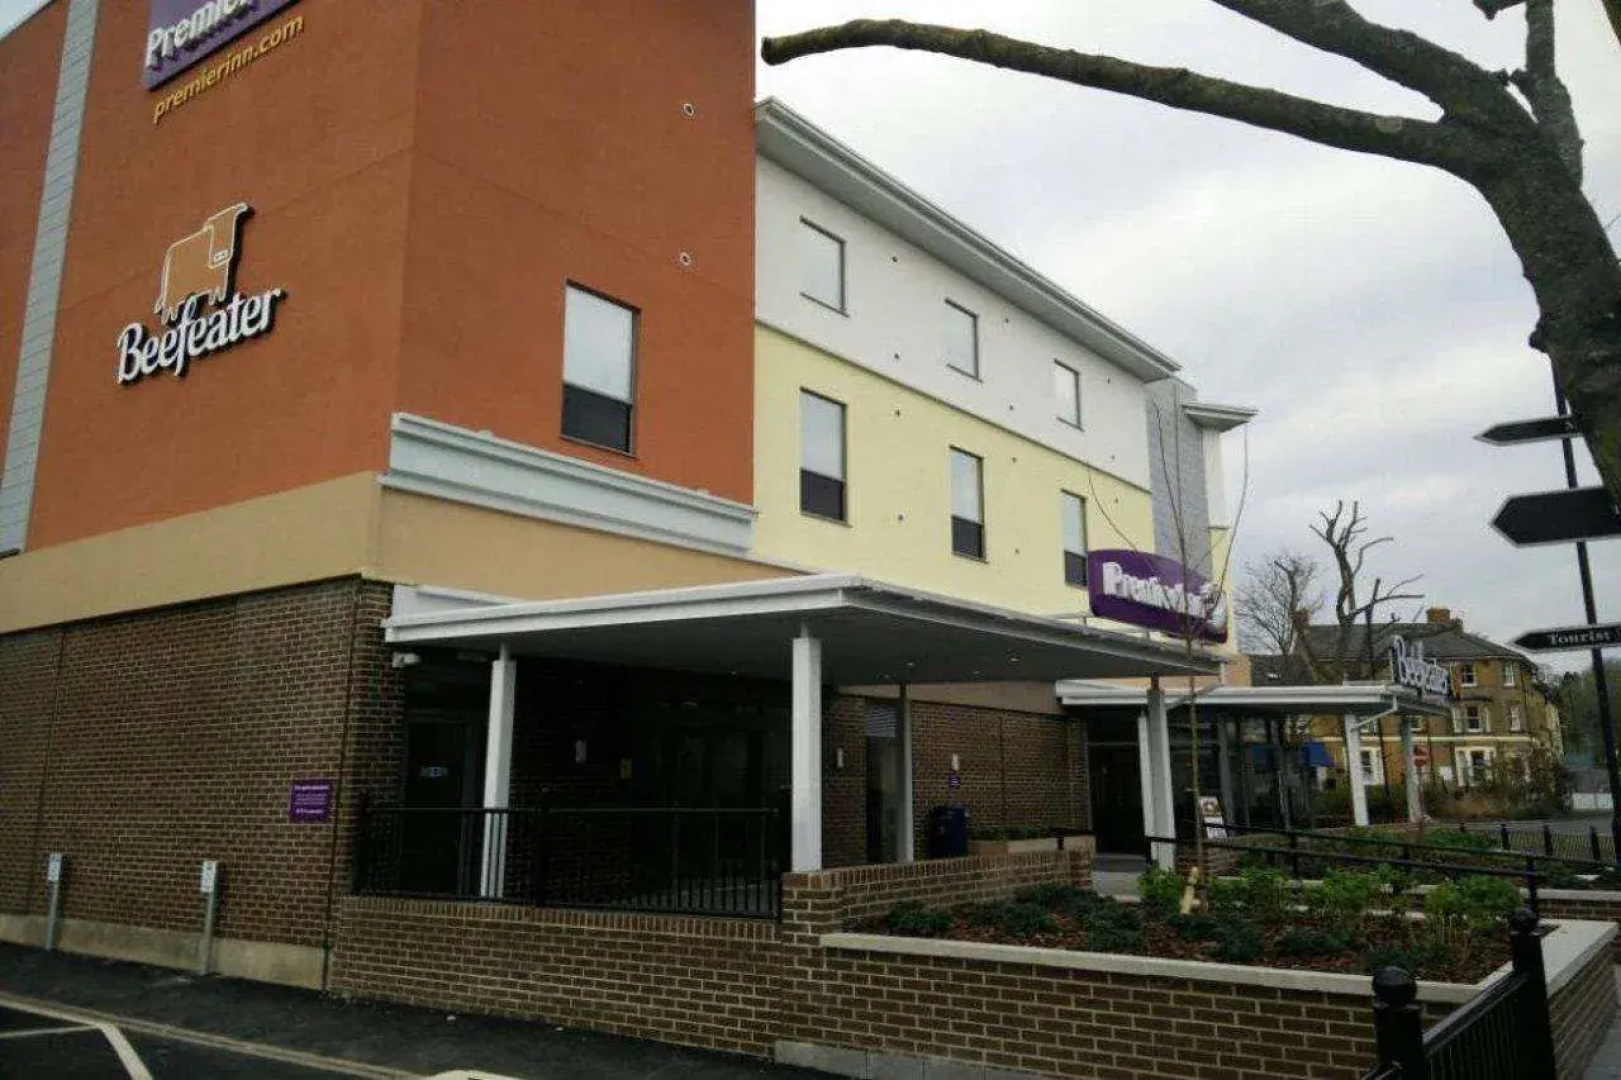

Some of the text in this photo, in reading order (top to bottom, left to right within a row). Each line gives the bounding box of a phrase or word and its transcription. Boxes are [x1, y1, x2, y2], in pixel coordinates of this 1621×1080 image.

[146, 0, 245, 67] Premie
[153, 15, 304, 124] premierinn.com
[117, 288, 282, 384] Beefeater
